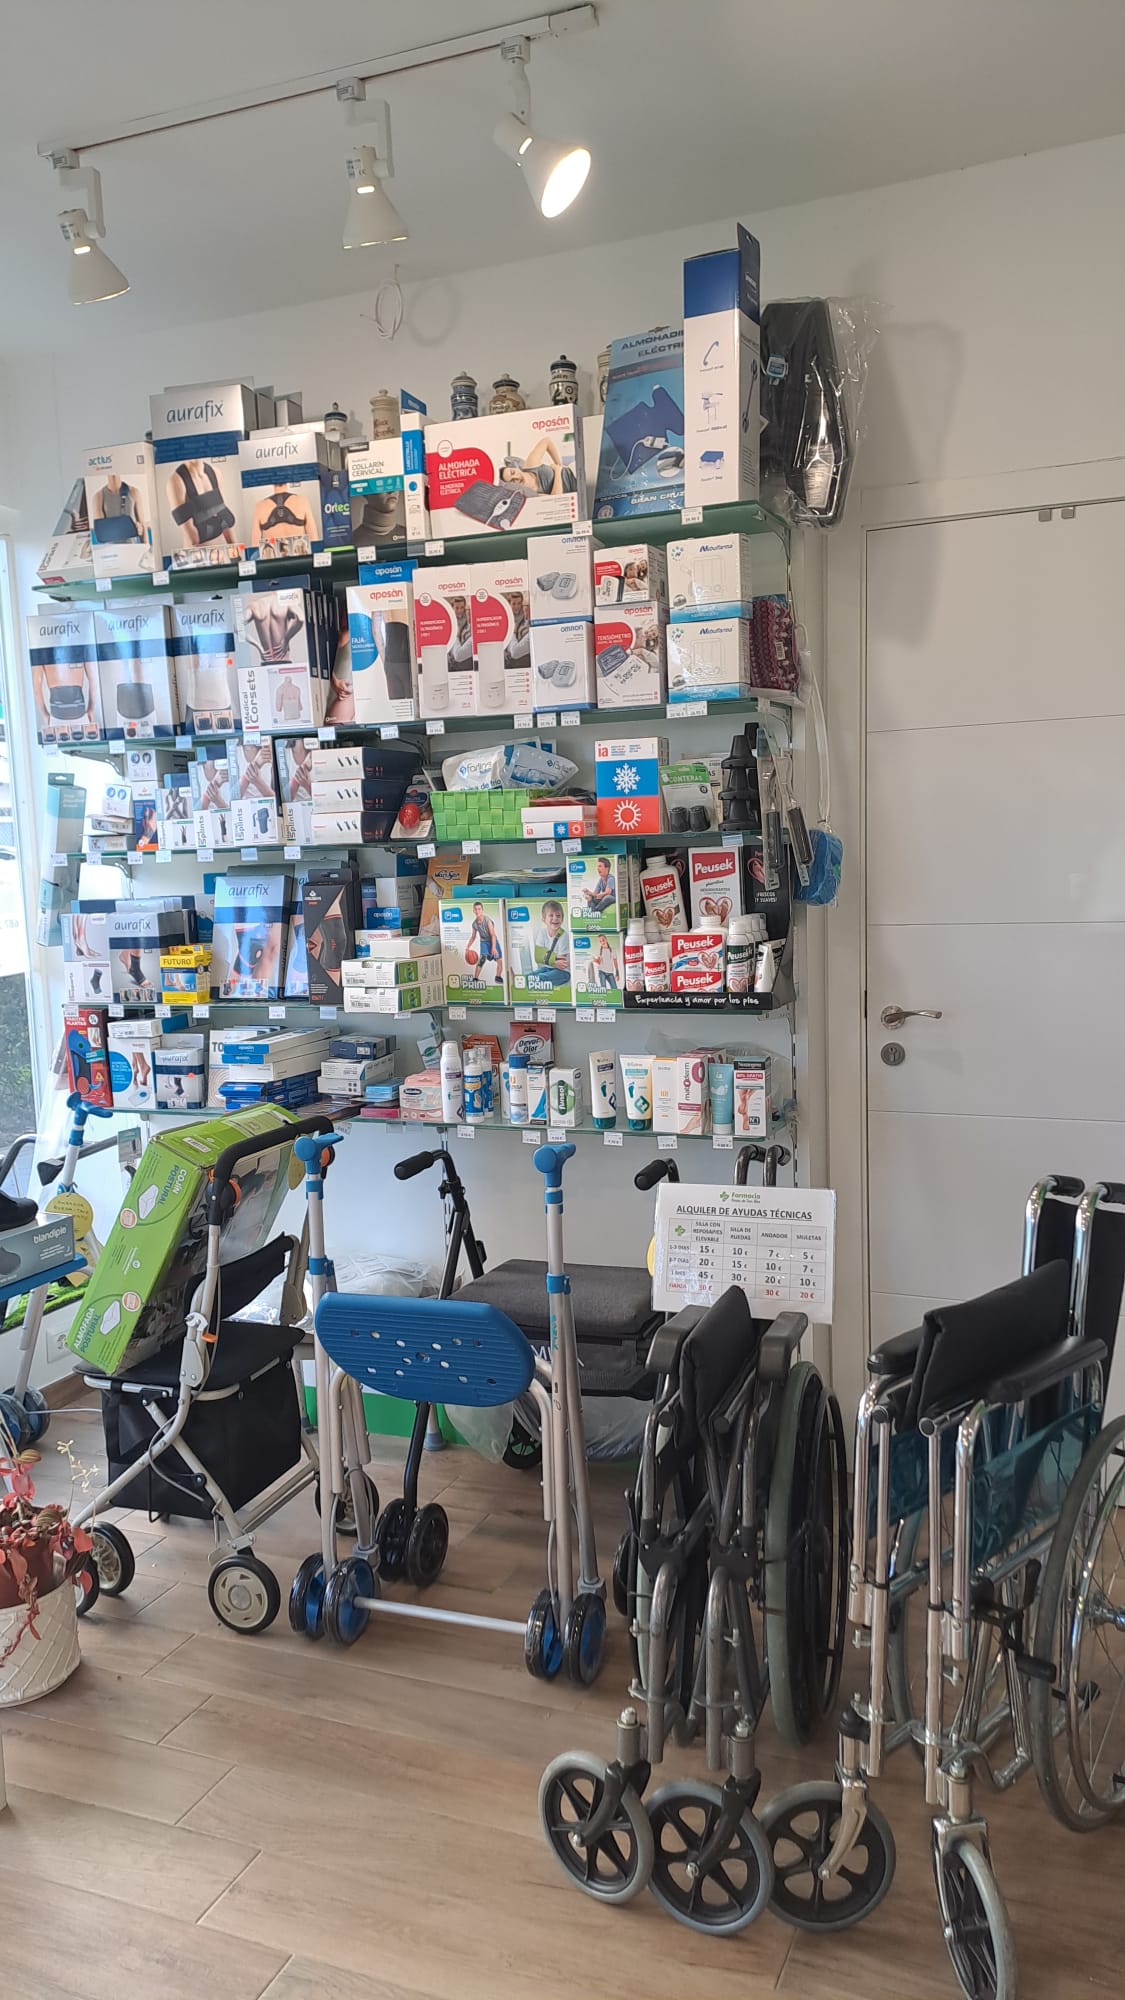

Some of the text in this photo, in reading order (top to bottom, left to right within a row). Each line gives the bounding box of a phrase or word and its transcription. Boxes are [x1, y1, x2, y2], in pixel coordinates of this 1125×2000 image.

[167, 400, 224, 423] aurafix
[532, 416, 570, 430] aposán
[255, 442, 299, 460] aurafix
[438, 459, 480, 471] ALMOHADA
[438, 467, 477, 480] ELÉCTRICA
[375, 565, 402, 576] aposán
[438, 581, 466, 591] aposán
[494, 577, 523, 587] aposán
[369, 588, 403, 601] aposán
[108, 615, 149, 632] aurafix
[181, 608, 225, 627] aurafix
[39, 621, 81, 637] aurafix
[694, 859, 734, 875] Peusek
[228, 883, 270, 901] aurafix
[644, 876, 674, 896] Peusek
[114, 918, 151, 932] aurafix
[677, 936, 714, 951] Peusek
[645, 964, 667, 973] Peusek
[677, 971, 714, 986] Peusek
[634, 995, 682, 1004] Experiencia
[684, 997, 691, 1006] y
[713, 997, 726, 1006] por
[729, 994, 740, 1004] los
[743, 996, 759, 1006] pies
[158, 1164, 180, 1205] POSTURAL
[676, 1205, 812, 1220] ALQUILER DE AYUDAS TÉCNICAS
[700, 1245, 709, 1253] 15
[732, 1247, 742, 1256] 10
[768, 1249, 774, 1257] 7
[802, 1251, 808, 1260] 5
[698, 1258, 709, 1266] 20
[732, 1260, 742, 1268] 15
[765, 1262, 776, 1271] 10
[698, 1271, 708, 1279] 45
[802, 1265, 808, 1273] 7
[731, 1273, 742, 1281] 30
[764, 1275, 775, 1284] 20
[800, 1278, 811, 1287] 10
[73, 1306, 95, 1349] ALMOFADA
